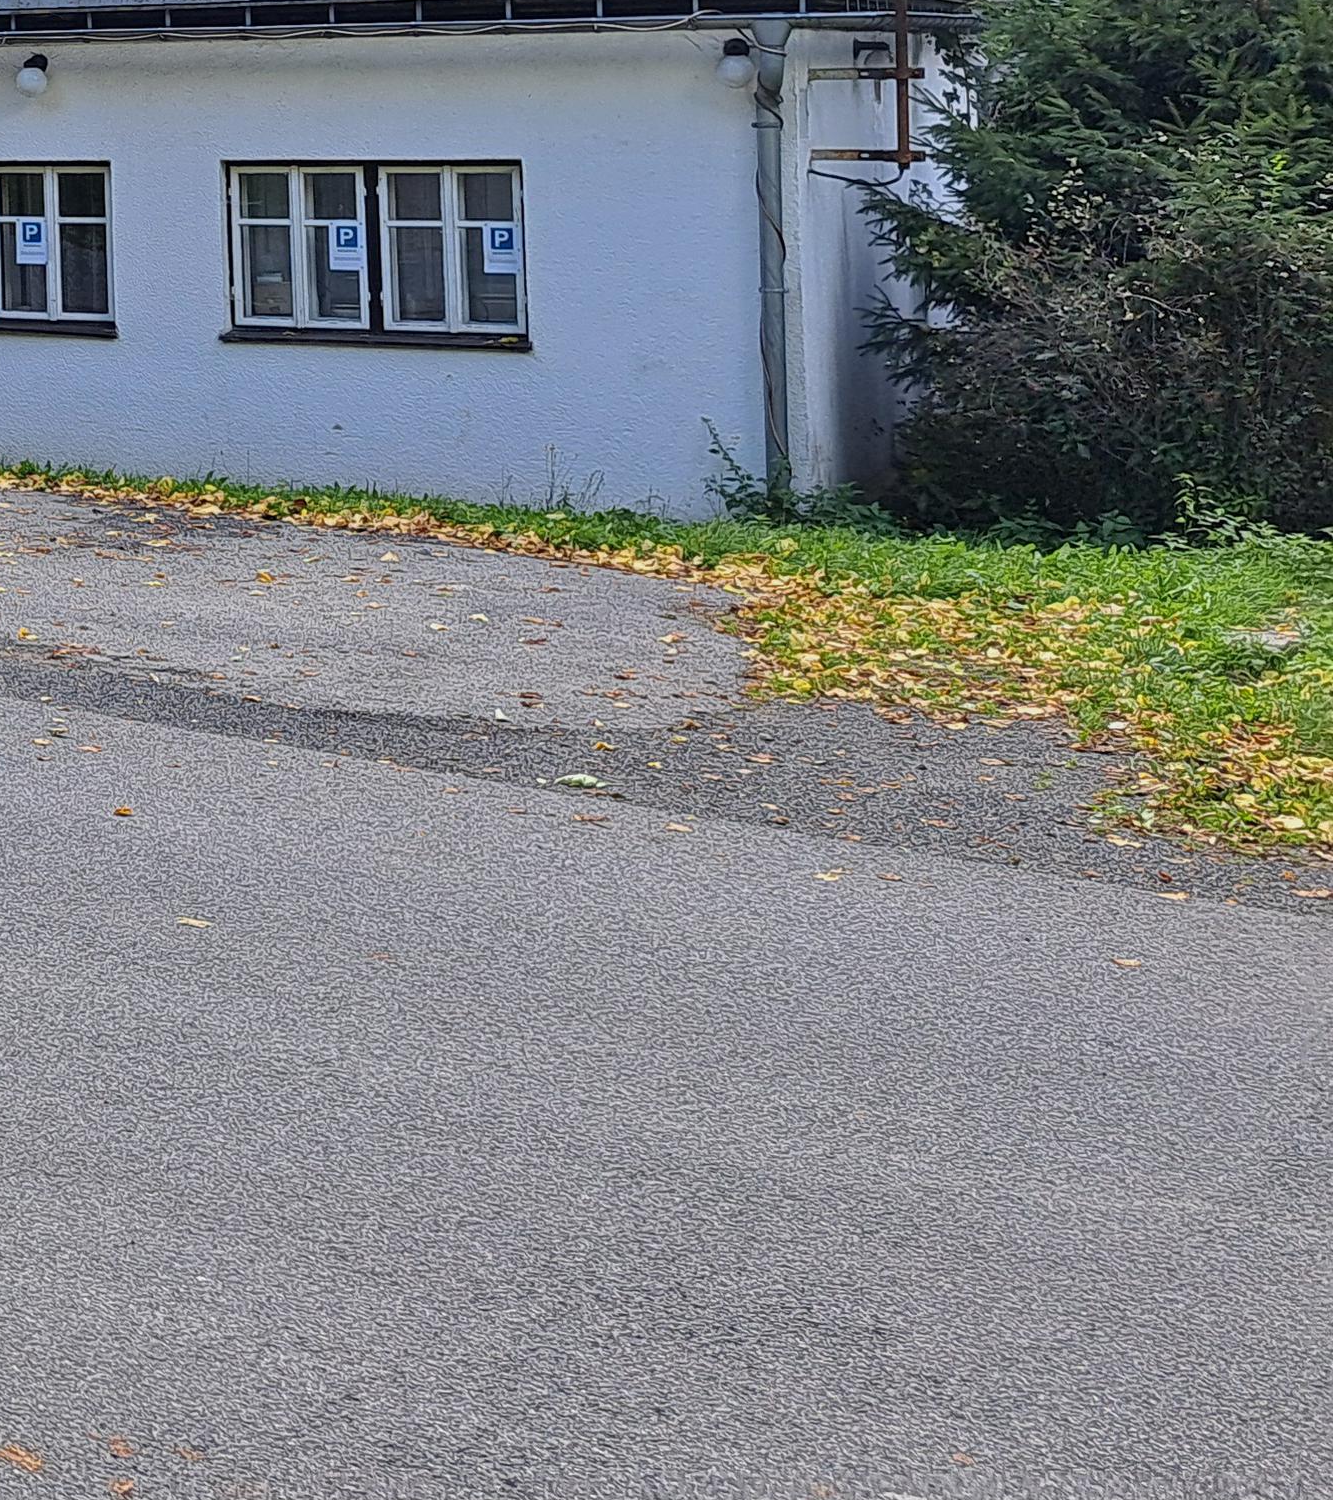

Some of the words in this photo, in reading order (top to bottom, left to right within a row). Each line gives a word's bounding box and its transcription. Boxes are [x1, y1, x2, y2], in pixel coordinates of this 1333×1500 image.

[25, 224, 39, 241] P
[339, 228, 354, 245] P
[494, 230, 510, 248] P
